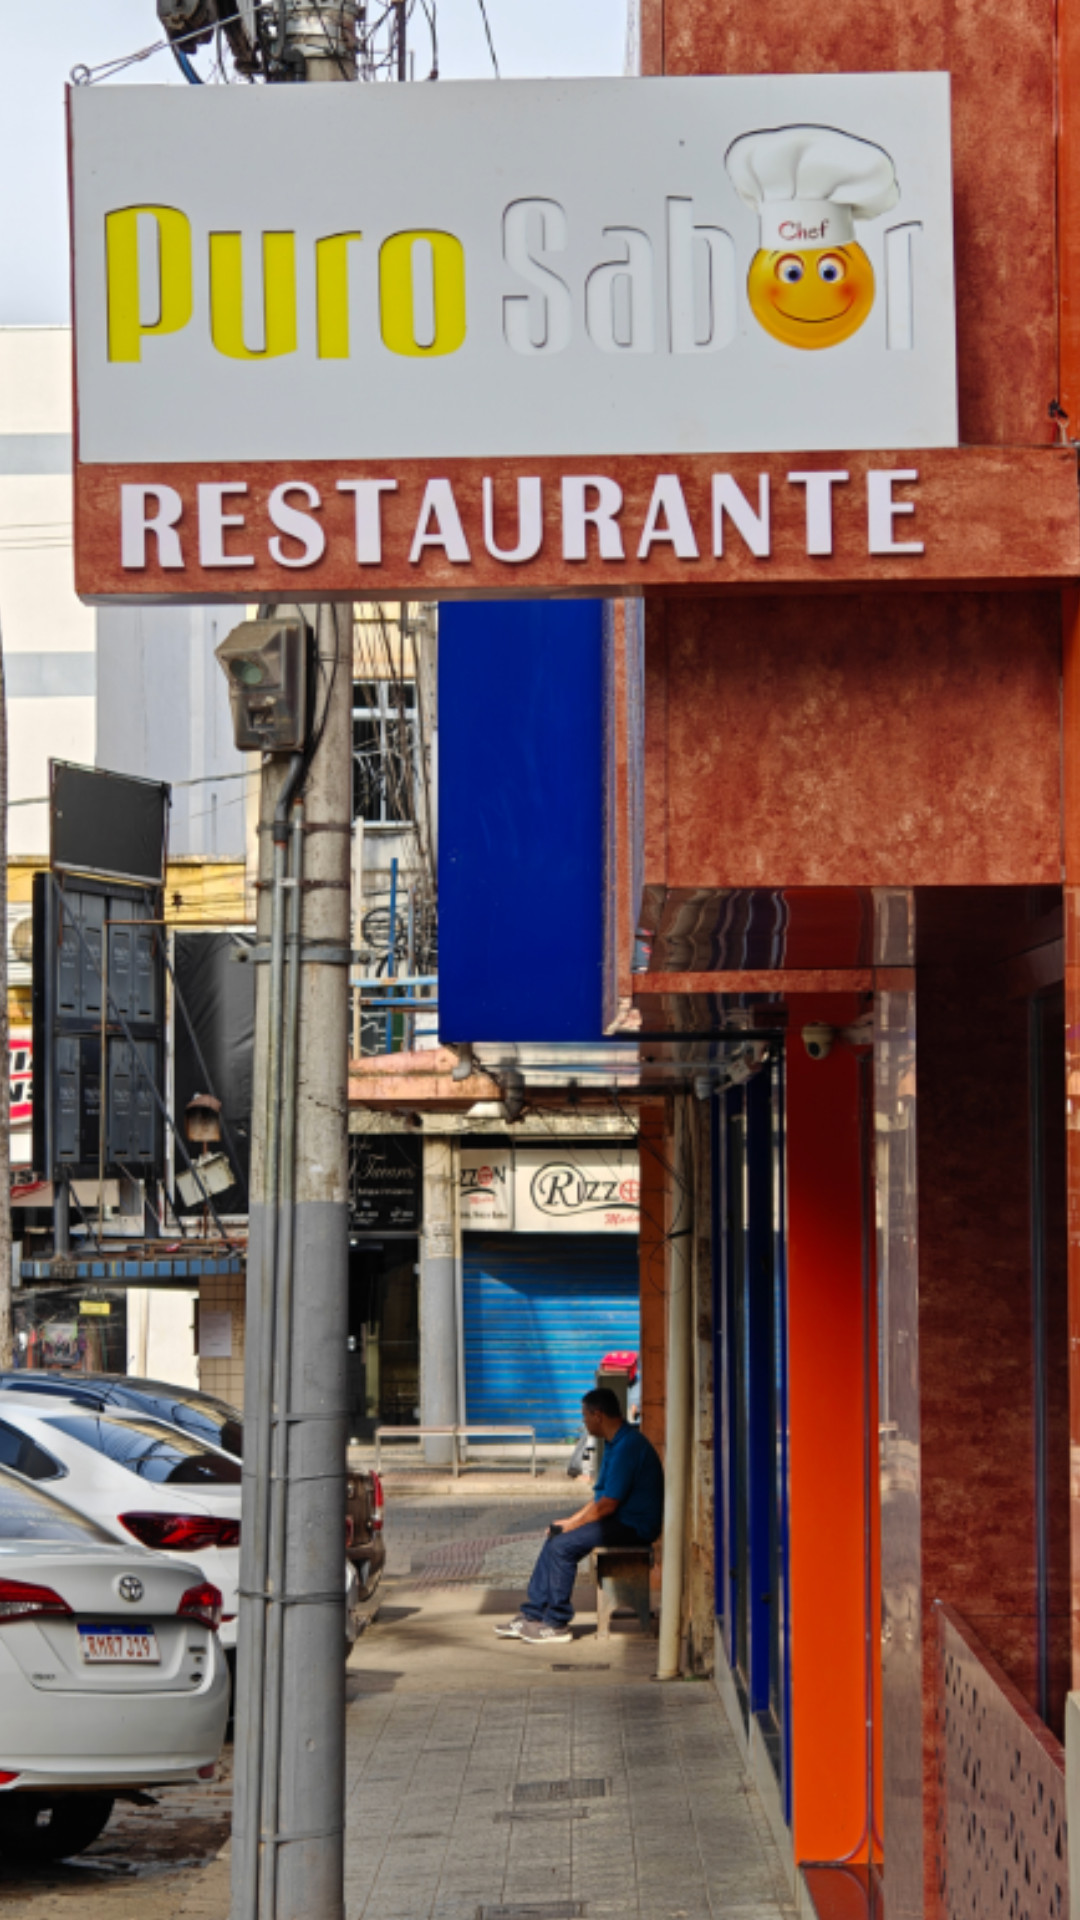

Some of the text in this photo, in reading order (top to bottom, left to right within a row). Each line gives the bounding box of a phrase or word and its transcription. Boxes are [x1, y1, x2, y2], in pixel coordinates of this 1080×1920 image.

[778, 218, 829, 240] Chef
[105, 203, 467, 363] Puro
[120, 468, 925, 570] RESTAURANTE
